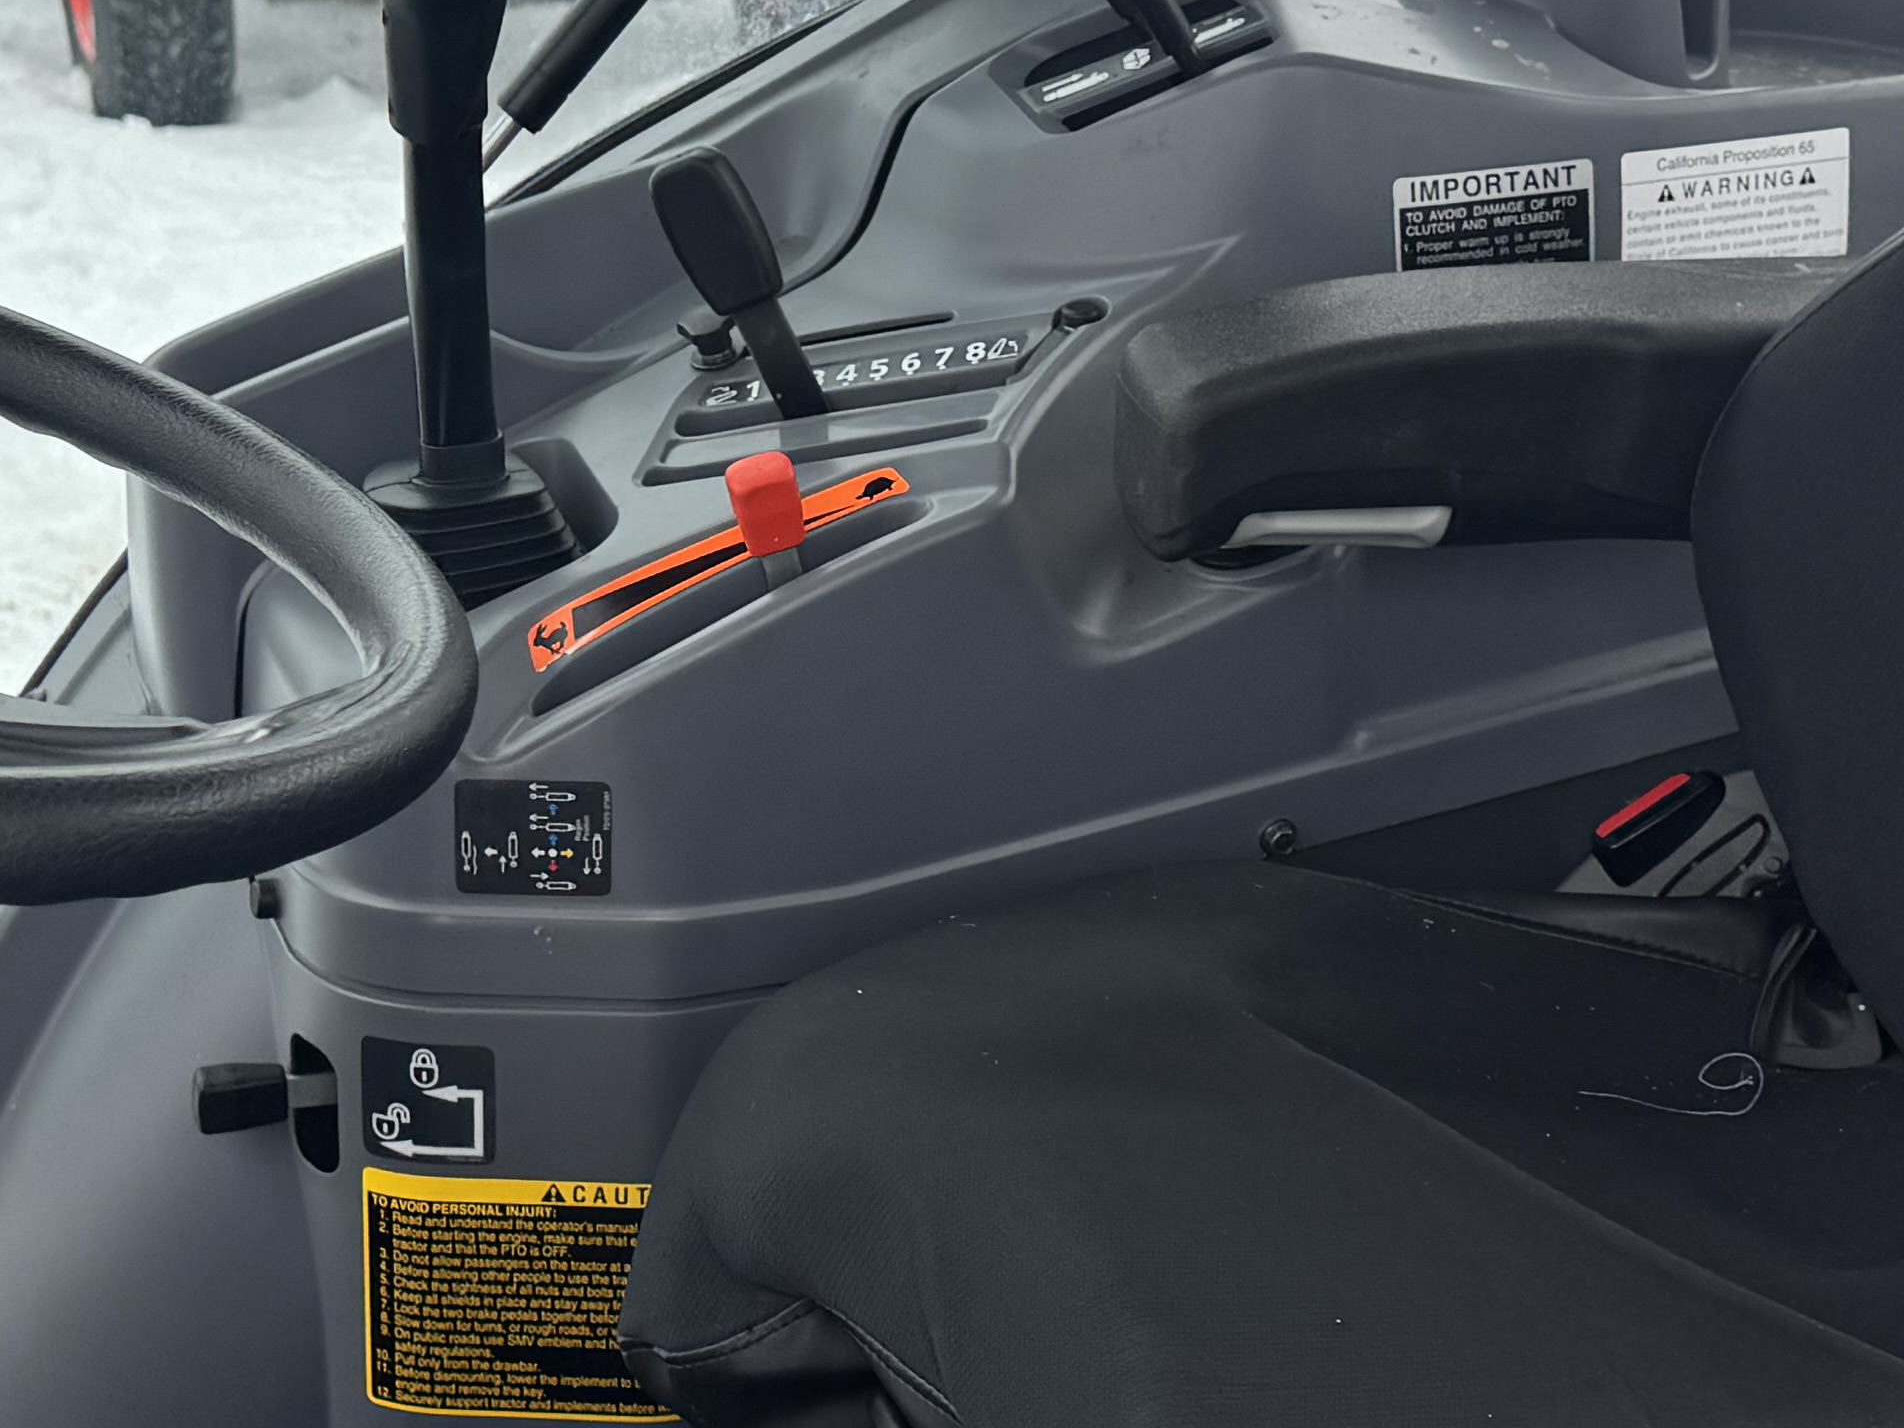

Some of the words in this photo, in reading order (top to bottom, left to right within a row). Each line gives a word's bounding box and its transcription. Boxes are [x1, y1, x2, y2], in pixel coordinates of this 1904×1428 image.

[1657, 151, 1718, 171] California
[1723, 142, 1795, 165] Proposition
[1798, 140, 1814, 154] 65
[1410, 164, 1577, 202] IMPORTANT
[1682, 169, 1794, 199] WARNING
[1405, 211, 1423, 223] TO
[1429, 206, 1466, 221] AVOID
[1473, 200, 1525, 216] DAMAGE
[1529, 198, 1547, 210] OF
[1552, 194, 1576, 208] PTO
[1405, 221, 1455, 237] CLUTCH
[1461, 217, 1487, 231] AND
[836, 364, 857, 382] 4
[869, 358, 889, 378] 5
[901, 352, 921, 372] 6
[935, 347, 954, 368] 7
[965, 341, 986, 361] 8
[371, 1193, 387, 1207] TO
[390, 1199, 429, 1213] AVOID
[432, 1201, 502, 1217] PERSONAL
[506, 1204, 556, 1218] INJURY:
[378, 1221, 389, 1233] 2.
[392, 1223, 428, 1239] Before
[431, 1228, 475, 1243] starting
[478, 1231, 496, 1242] the
[543, 1233, 575, 1245] make
[577, 1235, 602, 1246] sure
[605, 1234, 627, 1246] that
[379, 1209, 389, 1220] 1.
[392, 1211, 422, 1225] Read
[424, 1215, 446, 1227] and
[449, 1216, 513, 1230] understand
[515, 1219, 533, 1231] the
[536, 1218, 593, 1234] operator's
[392, 1238, 428, 1251] tractor
[430, 1242, 452, 1253] and
[454, 1242, 476, 1255] that
[478, 1244, 497, 1255] the
[500, 1243, 527, 1256] PTO
[529, 1245, 539, 1256] is
[542, 1244, 572, 1258] OFF.
[393, 1249, 408, 1263] Do
[411, 1252, 429, 1265] not
[431, 1254, 461, 1267] allow
[464, 1255, 529, 1271] passengers
[532, 1259, 546, 1269] on
[549, 1258, 567, 1270] the
[570, 1259, 607, 1272] tractor
[609, 1261, 621, 1272] at
[394, 1351, 415, 1364] Pull
[417, 1355, 440, 1369] only
[443, 1356, 469, 1369] from
[472, 1358, 490, 1370] the
